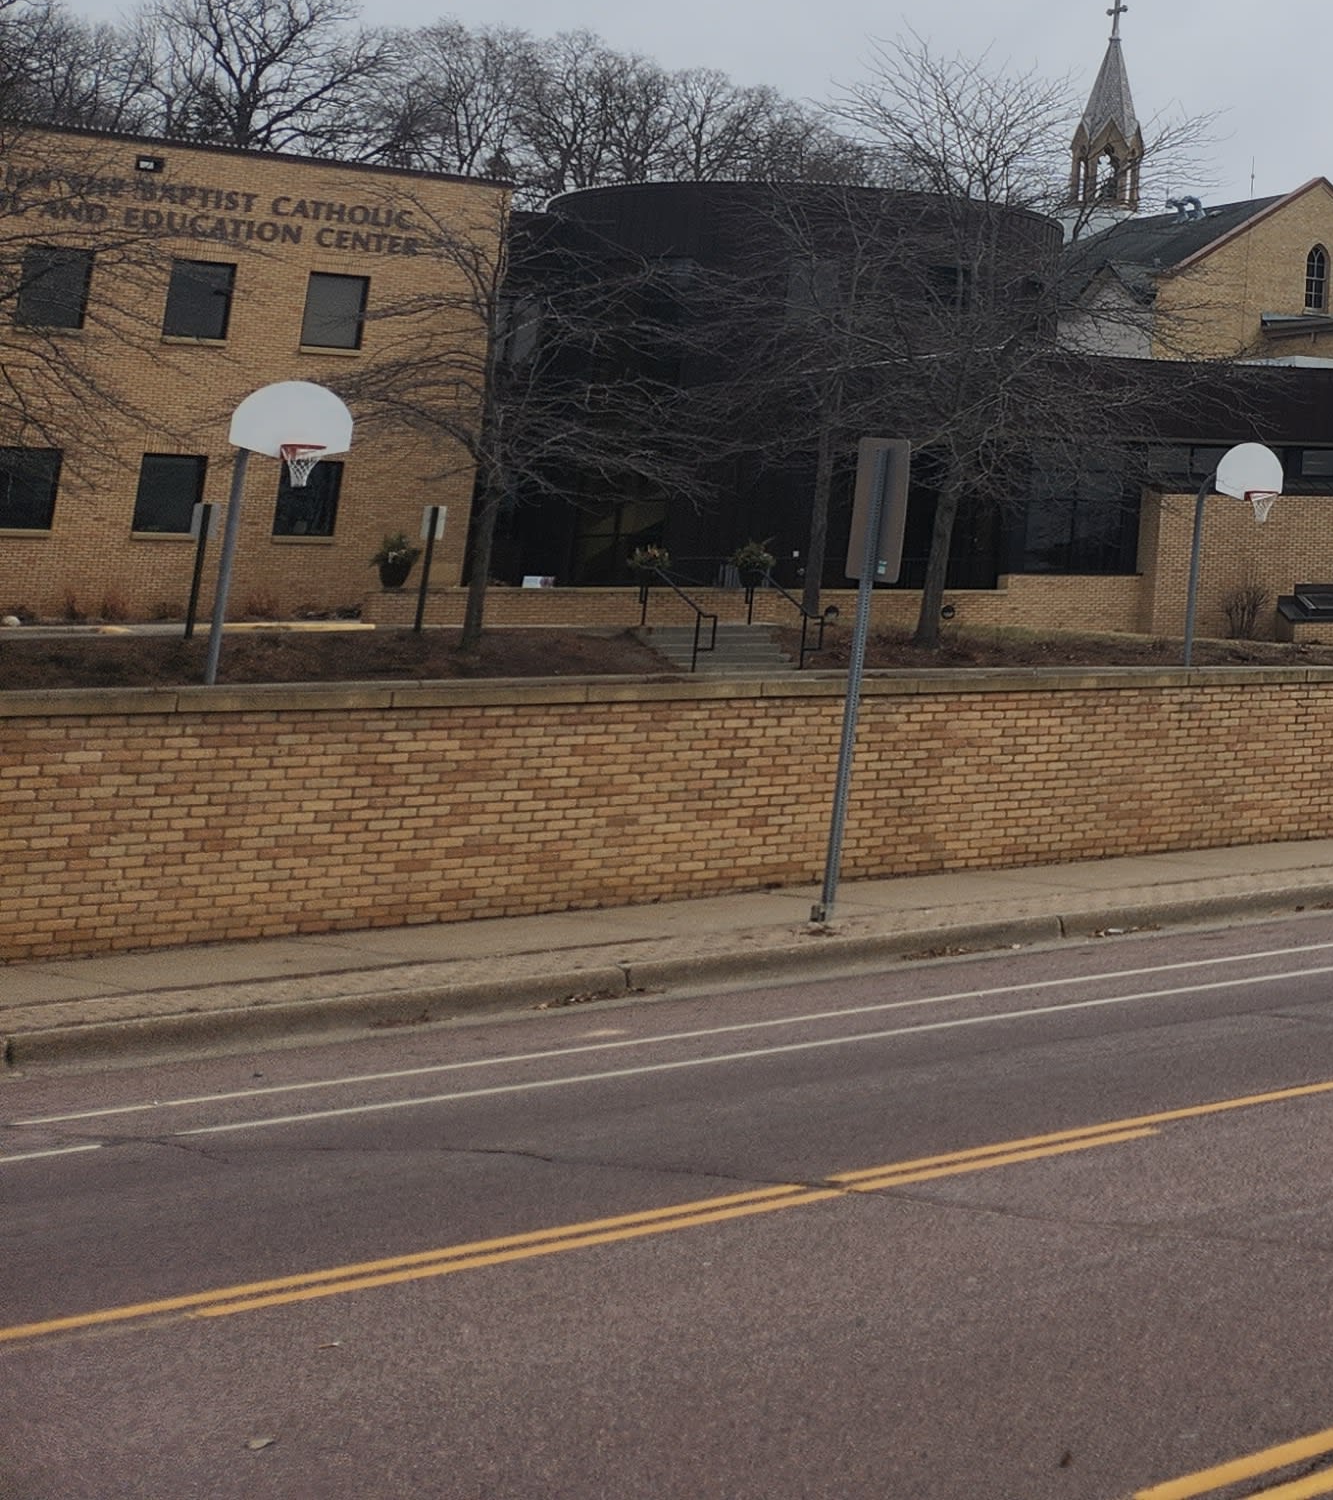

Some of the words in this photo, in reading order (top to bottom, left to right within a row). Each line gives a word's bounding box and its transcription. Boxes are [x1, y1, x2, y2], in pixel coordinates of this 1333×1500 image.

[41, 199, 108, 223] AND
[124, 206, 303, 244] EDUCATION
[315, 227, 419, 256] CENTER
[137, 178, 258, 212] BAPTIST
[271, 196, 414, 230] CATHOLIC
